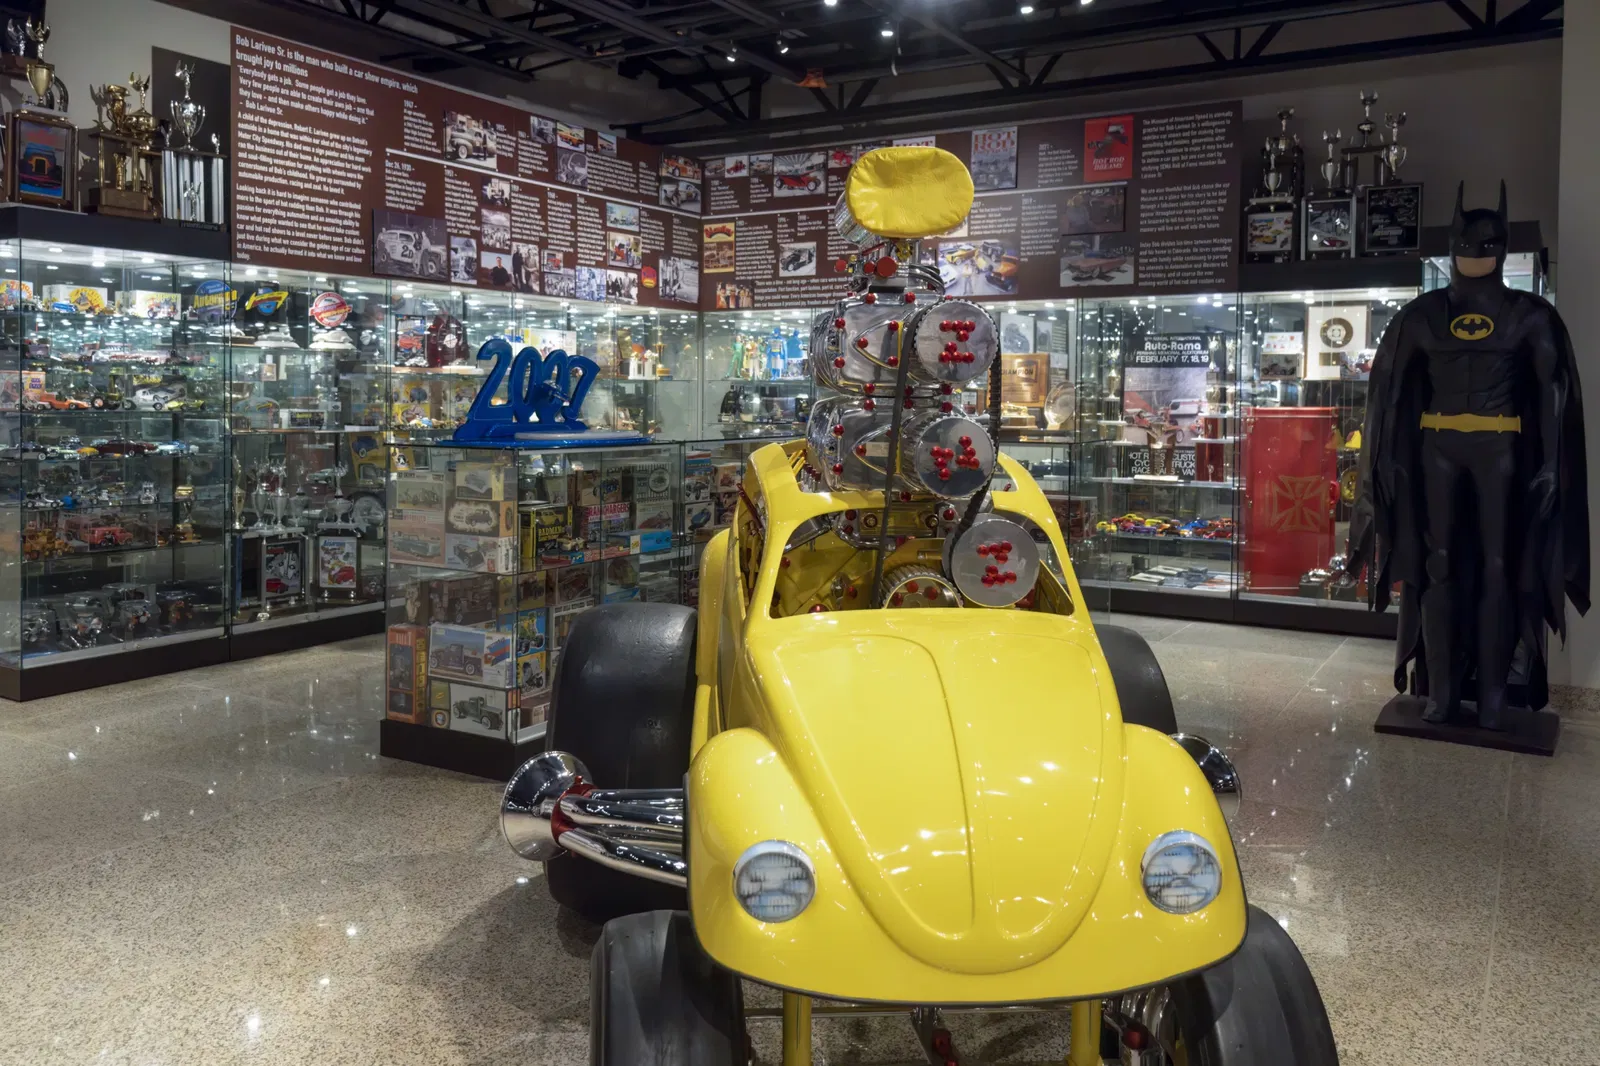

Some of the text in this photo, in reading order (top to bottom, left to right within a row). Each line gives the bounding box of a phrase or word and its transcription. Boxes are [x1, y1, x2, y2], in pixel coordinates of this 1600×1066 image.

[235, 49, 308, 77] brought joy to millions
[235, 34, 249, 47] Bob
[250, 38, 275, 54] Larivee
[276, 45, 285, 57] Sr.
[287, 48, 292, 59] is
[294, 50, 304, 62] the
[305, 56, 319, 66] man
[320, 57, 333, 70] who
[334, 61, 347, 74] built
[354, 69, 363, 78] car
[364, 69, 379, 82] show
[402, 80, 417, 93] which
[238, 75, 250, 87] Very
[252, 79, 261, 88] few
[262, 81, 279, 94] people
[290, 88, 300, 98] able
[301, 91, 305, 99] to
[307, 92, 322, 103] create
[323, 96, 333, 106] their
[365, 107, 374, 116] that
[267, 72, 278, 83] gets
[283, 76, 293, 87] job.
[295, 79, 308, 89] Some
[309, 82, 325, 95] people
[326, 87, 334, 97] get
[346, 92, 355, 103] they
[238, 87, 250, 99] they
[251, 90, 262, 99] love
[267, 94, 277, 103] and
[278, 96, 289, 106] then
[290, 99, 303, 109] make
[304, 102, 319, 113] others
[320, 106, 334, 118] happy
[335, 110, 347, 119] while
[348, 113, 360, 124] doing
[245, 99, 255, 109] Bob
[256, 102, 275, 114] Larivee
[1136, 355, 1178, 363] FEBRUARY
[1201, 355, 1209, 363] 19
[1145, 341, 1201, 351] Auto-Rama
